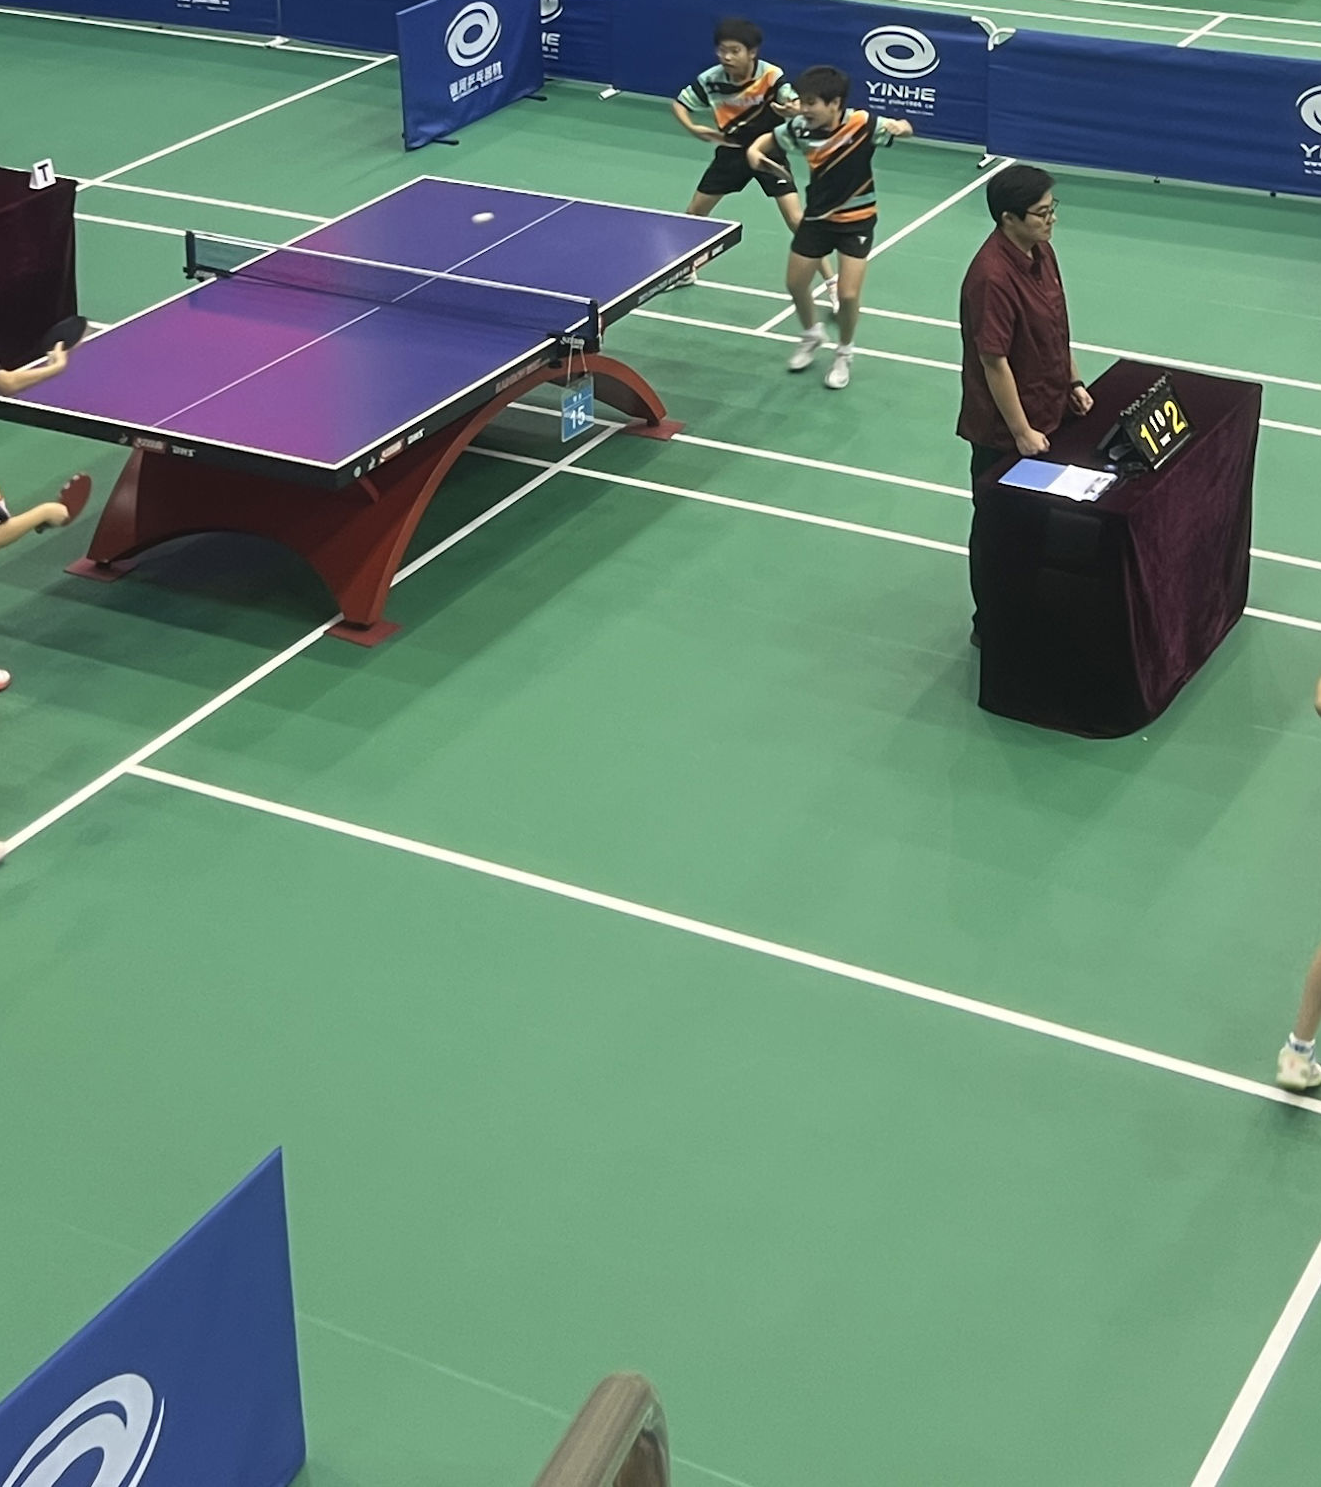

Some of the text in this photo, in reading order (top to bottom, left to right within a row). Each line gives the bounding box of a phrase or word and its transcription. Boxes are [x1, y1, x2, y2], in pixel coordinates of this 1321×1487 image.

[865, 80, 937, 102] YINHE
[37, 163, 49, 181] T
[569, 405, 586, 429] 15
[1140, 424, 1158, 454] 1
[1164, 400, 1185, 434] 2
